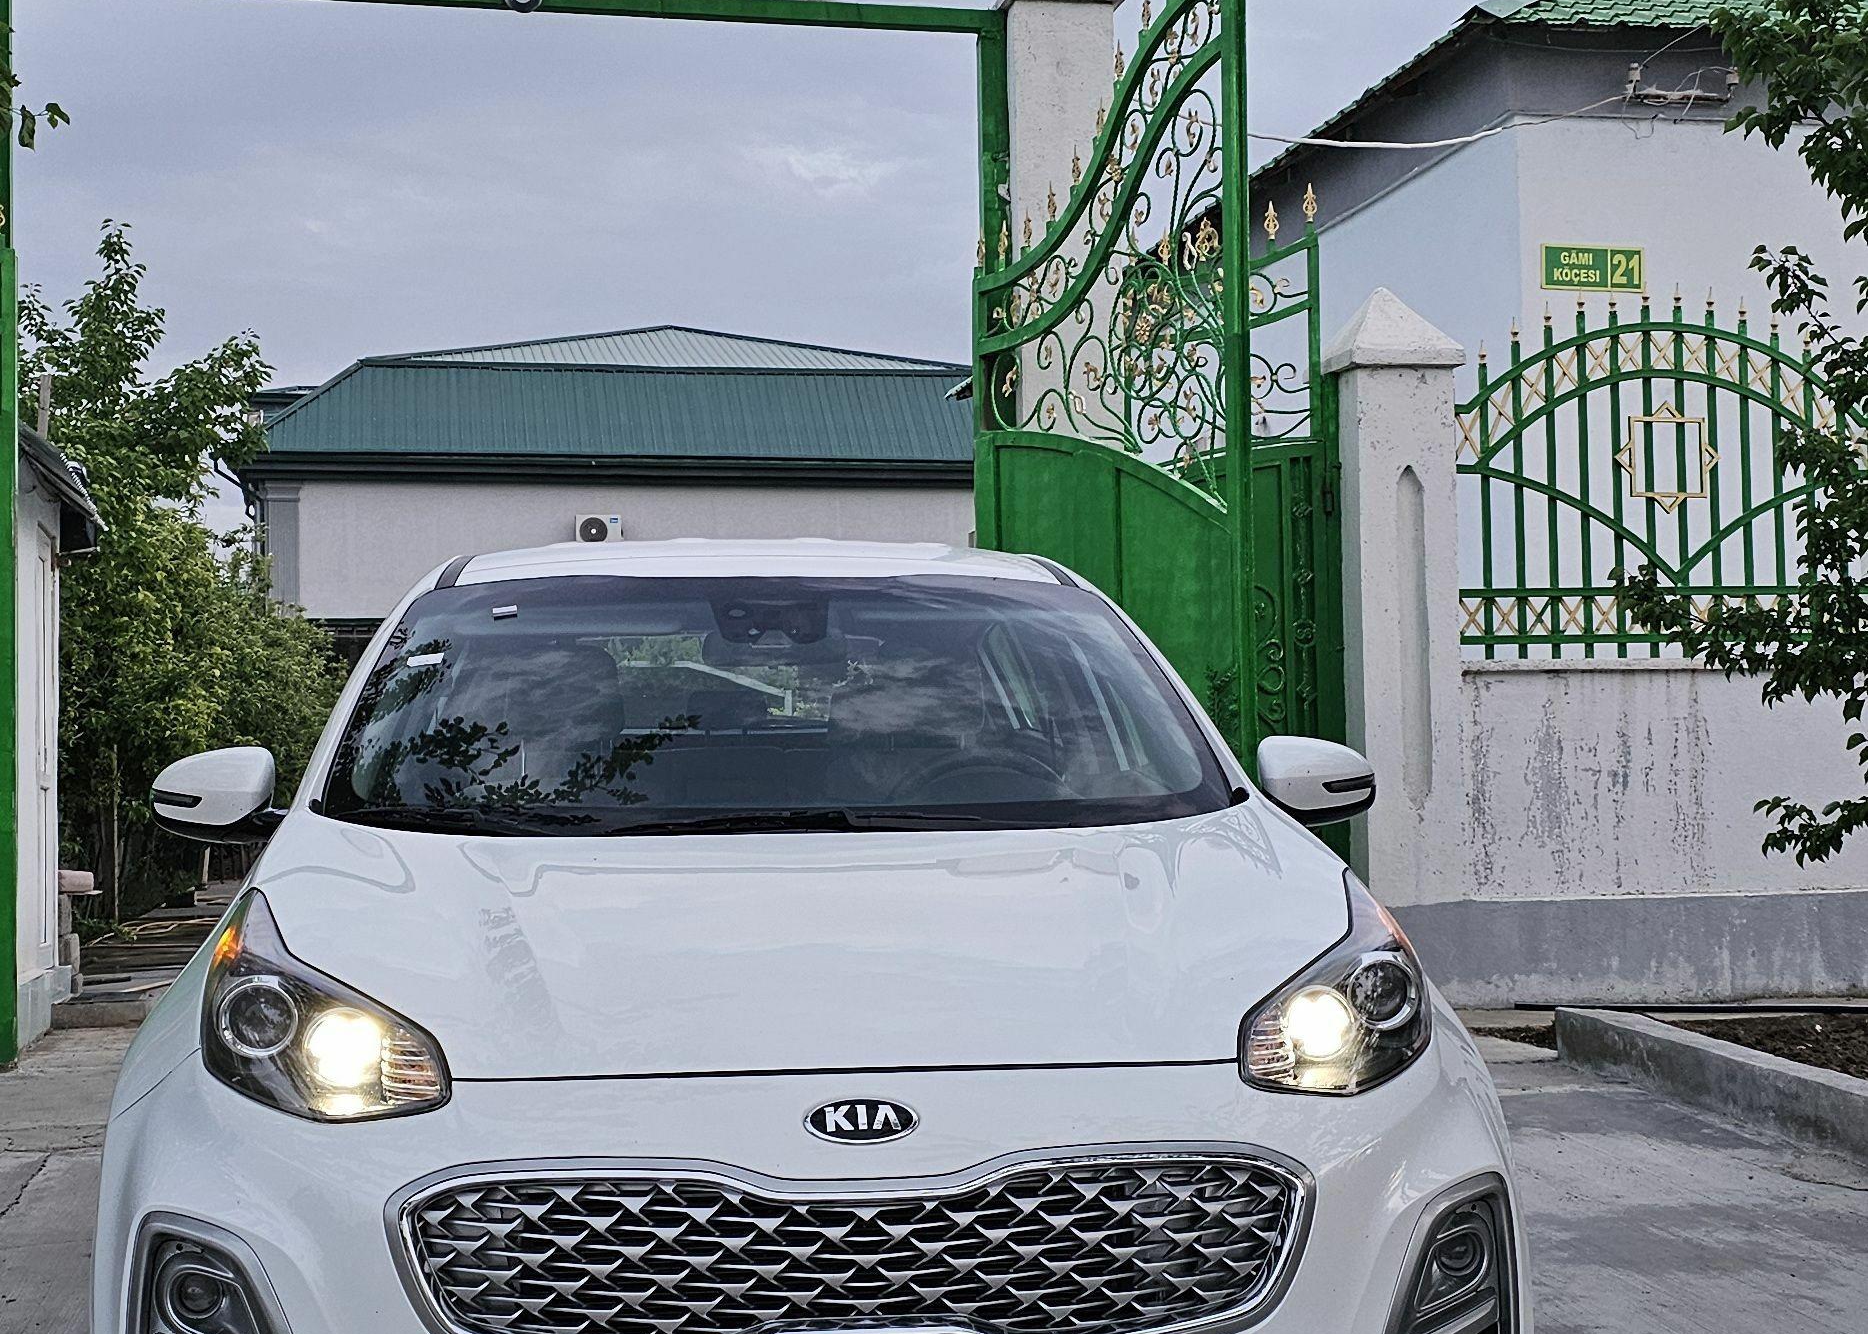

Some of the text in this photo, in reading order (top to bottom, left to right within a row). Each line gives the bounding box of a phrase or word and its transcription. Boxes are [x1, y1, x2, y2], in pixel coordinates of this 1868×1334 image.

[1560, 250, 1593, 266] GÄMI
[1611, 253, 1640, 285] 21
[1553, 266, 1600, 285] KÖÇESI
[823, 1104, 902, 1133] KIA
